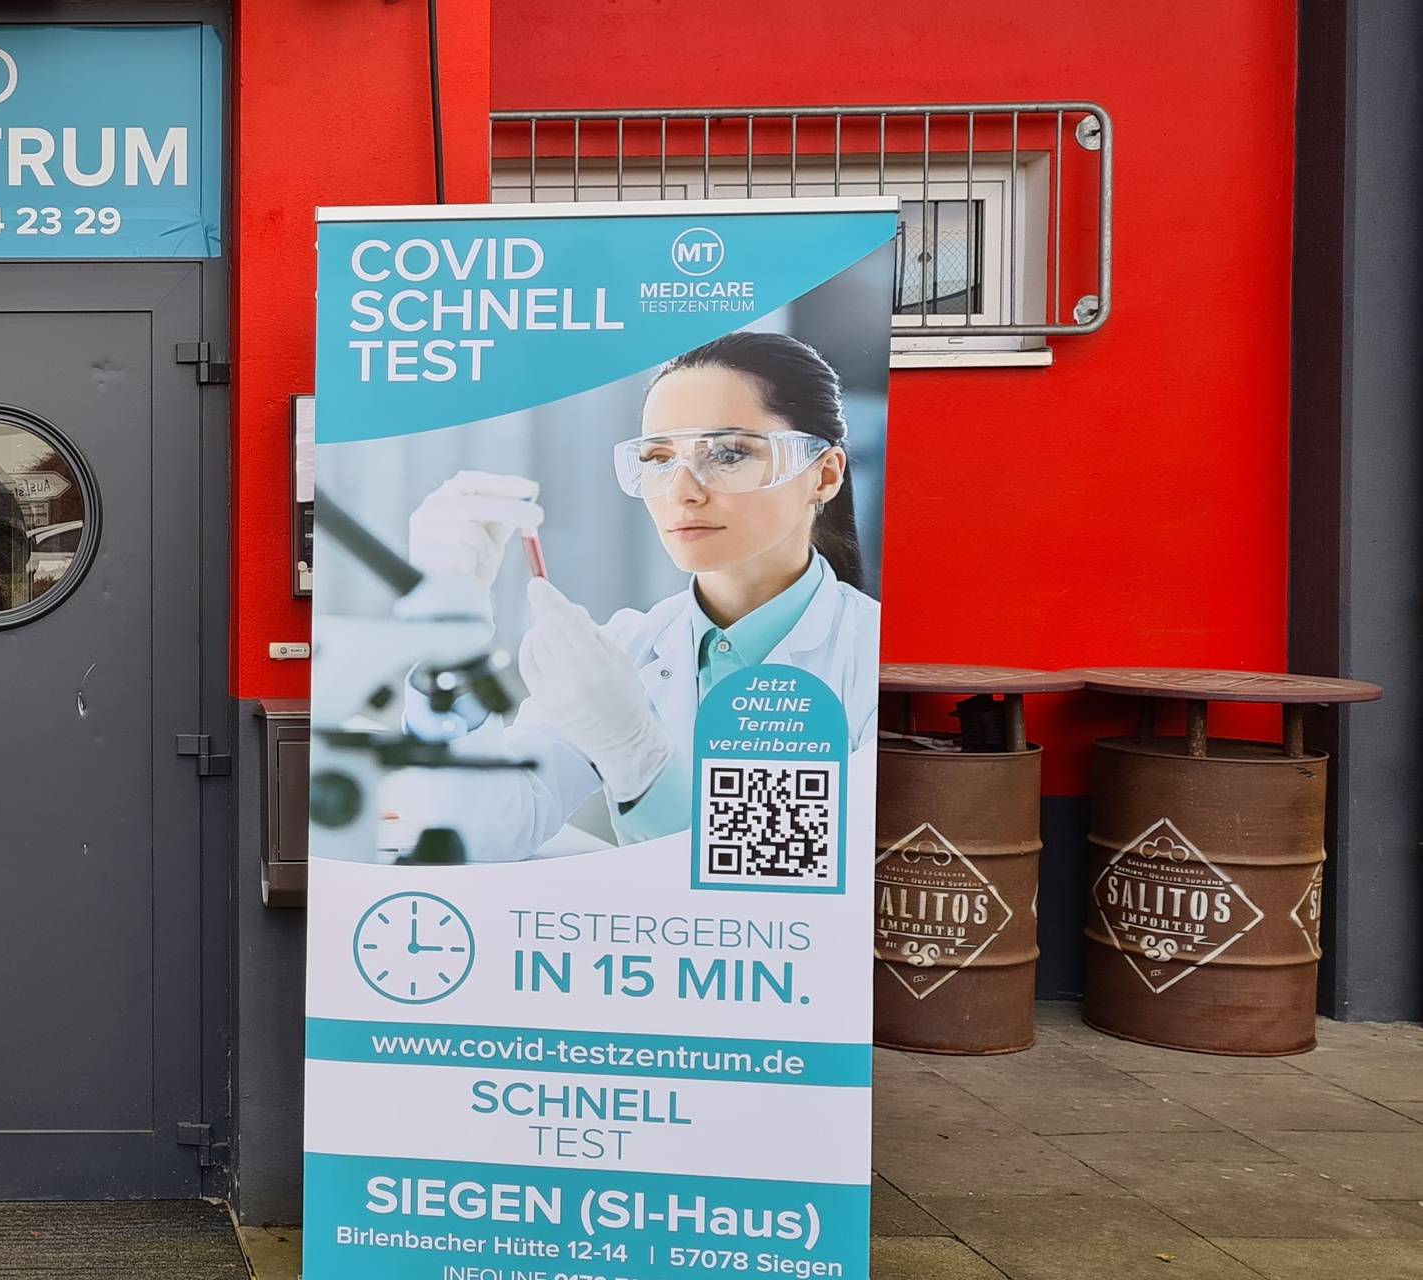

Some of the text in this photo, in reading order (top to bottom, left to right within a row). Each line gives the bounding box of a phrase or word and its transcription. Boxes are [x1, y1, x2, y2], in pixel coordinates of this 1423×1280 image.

[17, 207, 65, 236] 23
[73, 207, 122, 236] 29
[350, 237, 544, 282] COVID
[678, 242, 719, 262] MT
[639, 299, 755, 314] TESTZENTRUM
[640, 281, 754, 298] MEDICARE
[349, 287, 625, 332] SCHNELL
[349, 339, 495, 382] TEST
[745, 677, 798, 692] Jetzt
[731, 697, 811, 712] ONLINE
[737, 717, 804, 732] Termin
[709, 737, 831, 753] vereinbaren
[879, 887, 989, 925] ALITOS
[1107, 875, 1231, 923] SALITOS
[509, 909, 811, 951] TESTERGEBNIS
[880, 918, 966, 937] IMPORTED
[1121, 911, 1205, 934] IMPORTED
[514, 950, 811, 1006] IN 15 MIN.
[371, 1033, 805, 1076] www.covid-testzentrum.de
[471, 1080, 692, 1126] SCHNELL
[528, 1126, 633, 1161] TEST
[365, 1177, 821, 1252] SIEGEN (SI-Haus)
[336, 1226, 487, 1254] Birlenbacher
[493, 1235, 560, 1259] Hütte
[567, 1241, 628, 1264] 12-14
[670, 1248, 749, 1272] 57078
[756, 1252, 844, 1280] Siegen
